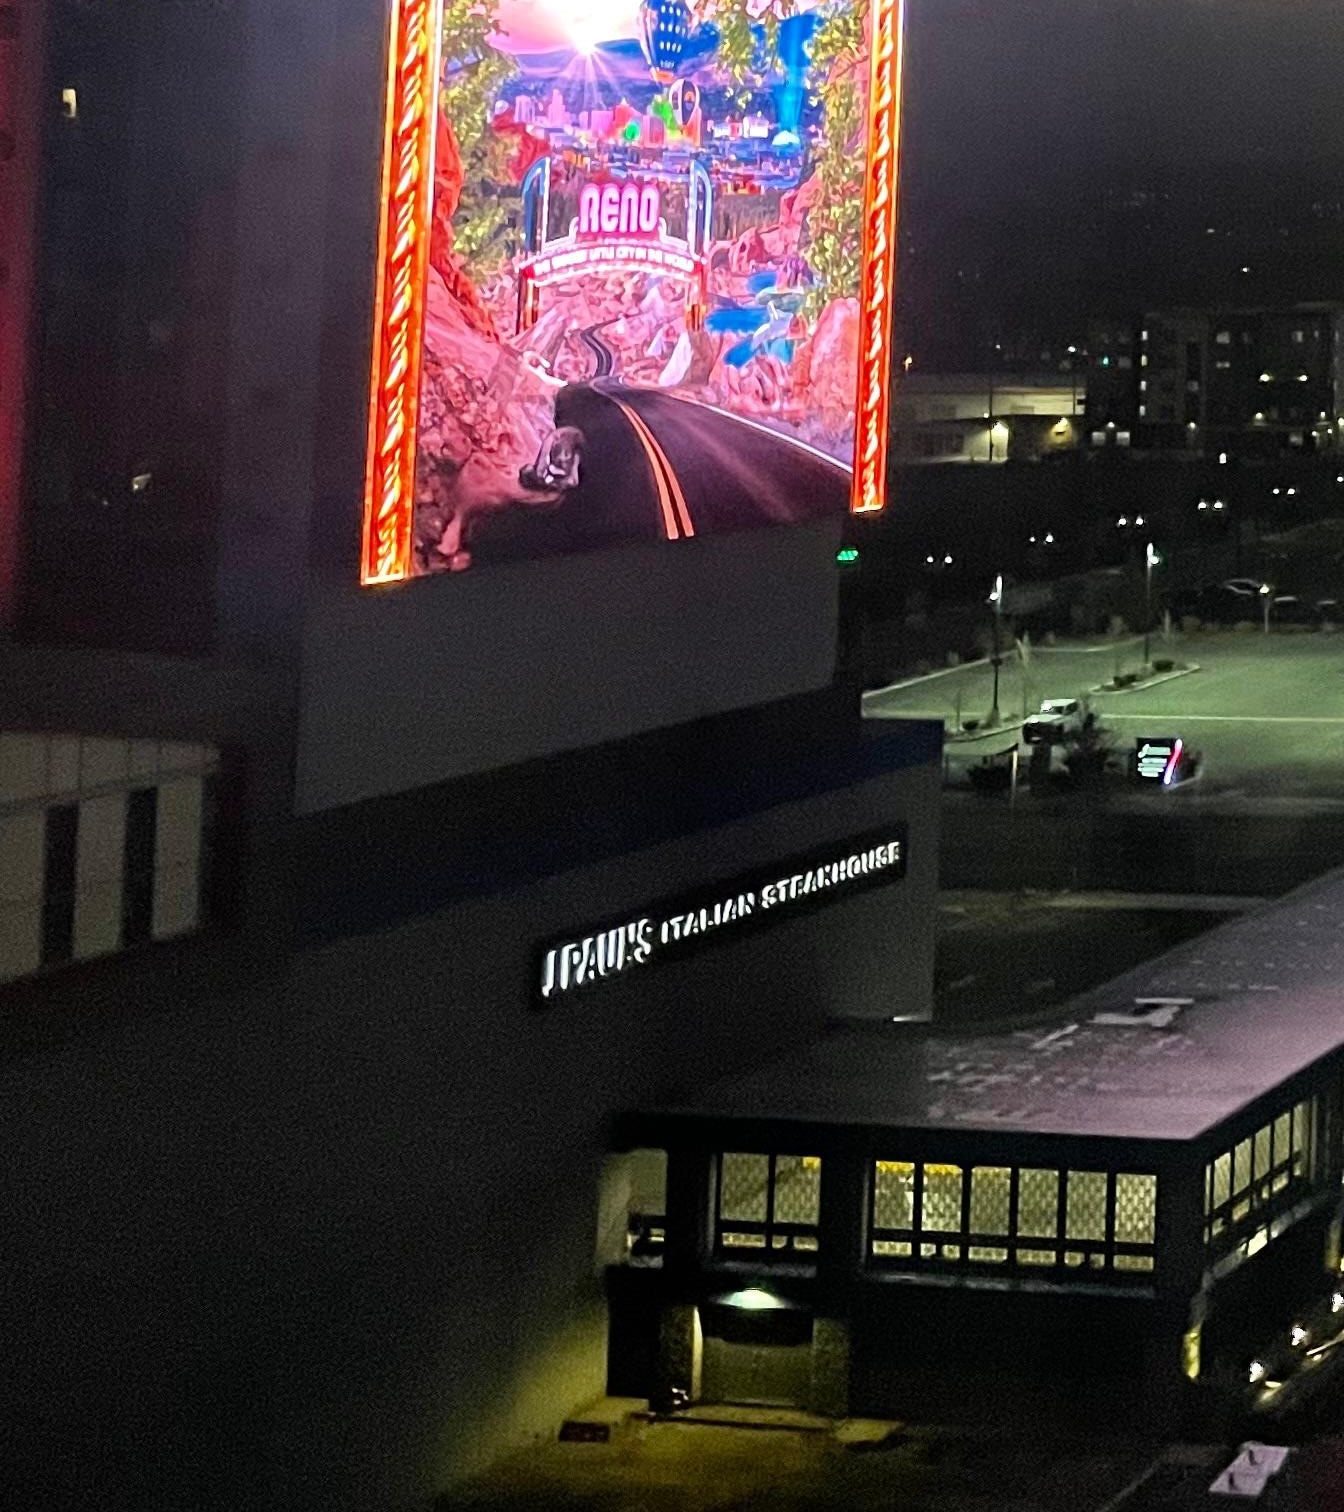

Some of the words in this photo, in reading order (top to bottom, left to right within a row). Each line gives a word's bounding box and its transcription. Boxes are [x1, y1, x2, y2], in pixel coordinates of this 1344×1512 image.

[579, 183, 659, 233] RENO
[661, 892, 755, 944] ITALIAN
[761, 841, 900, 908] STEAKHOUSE
